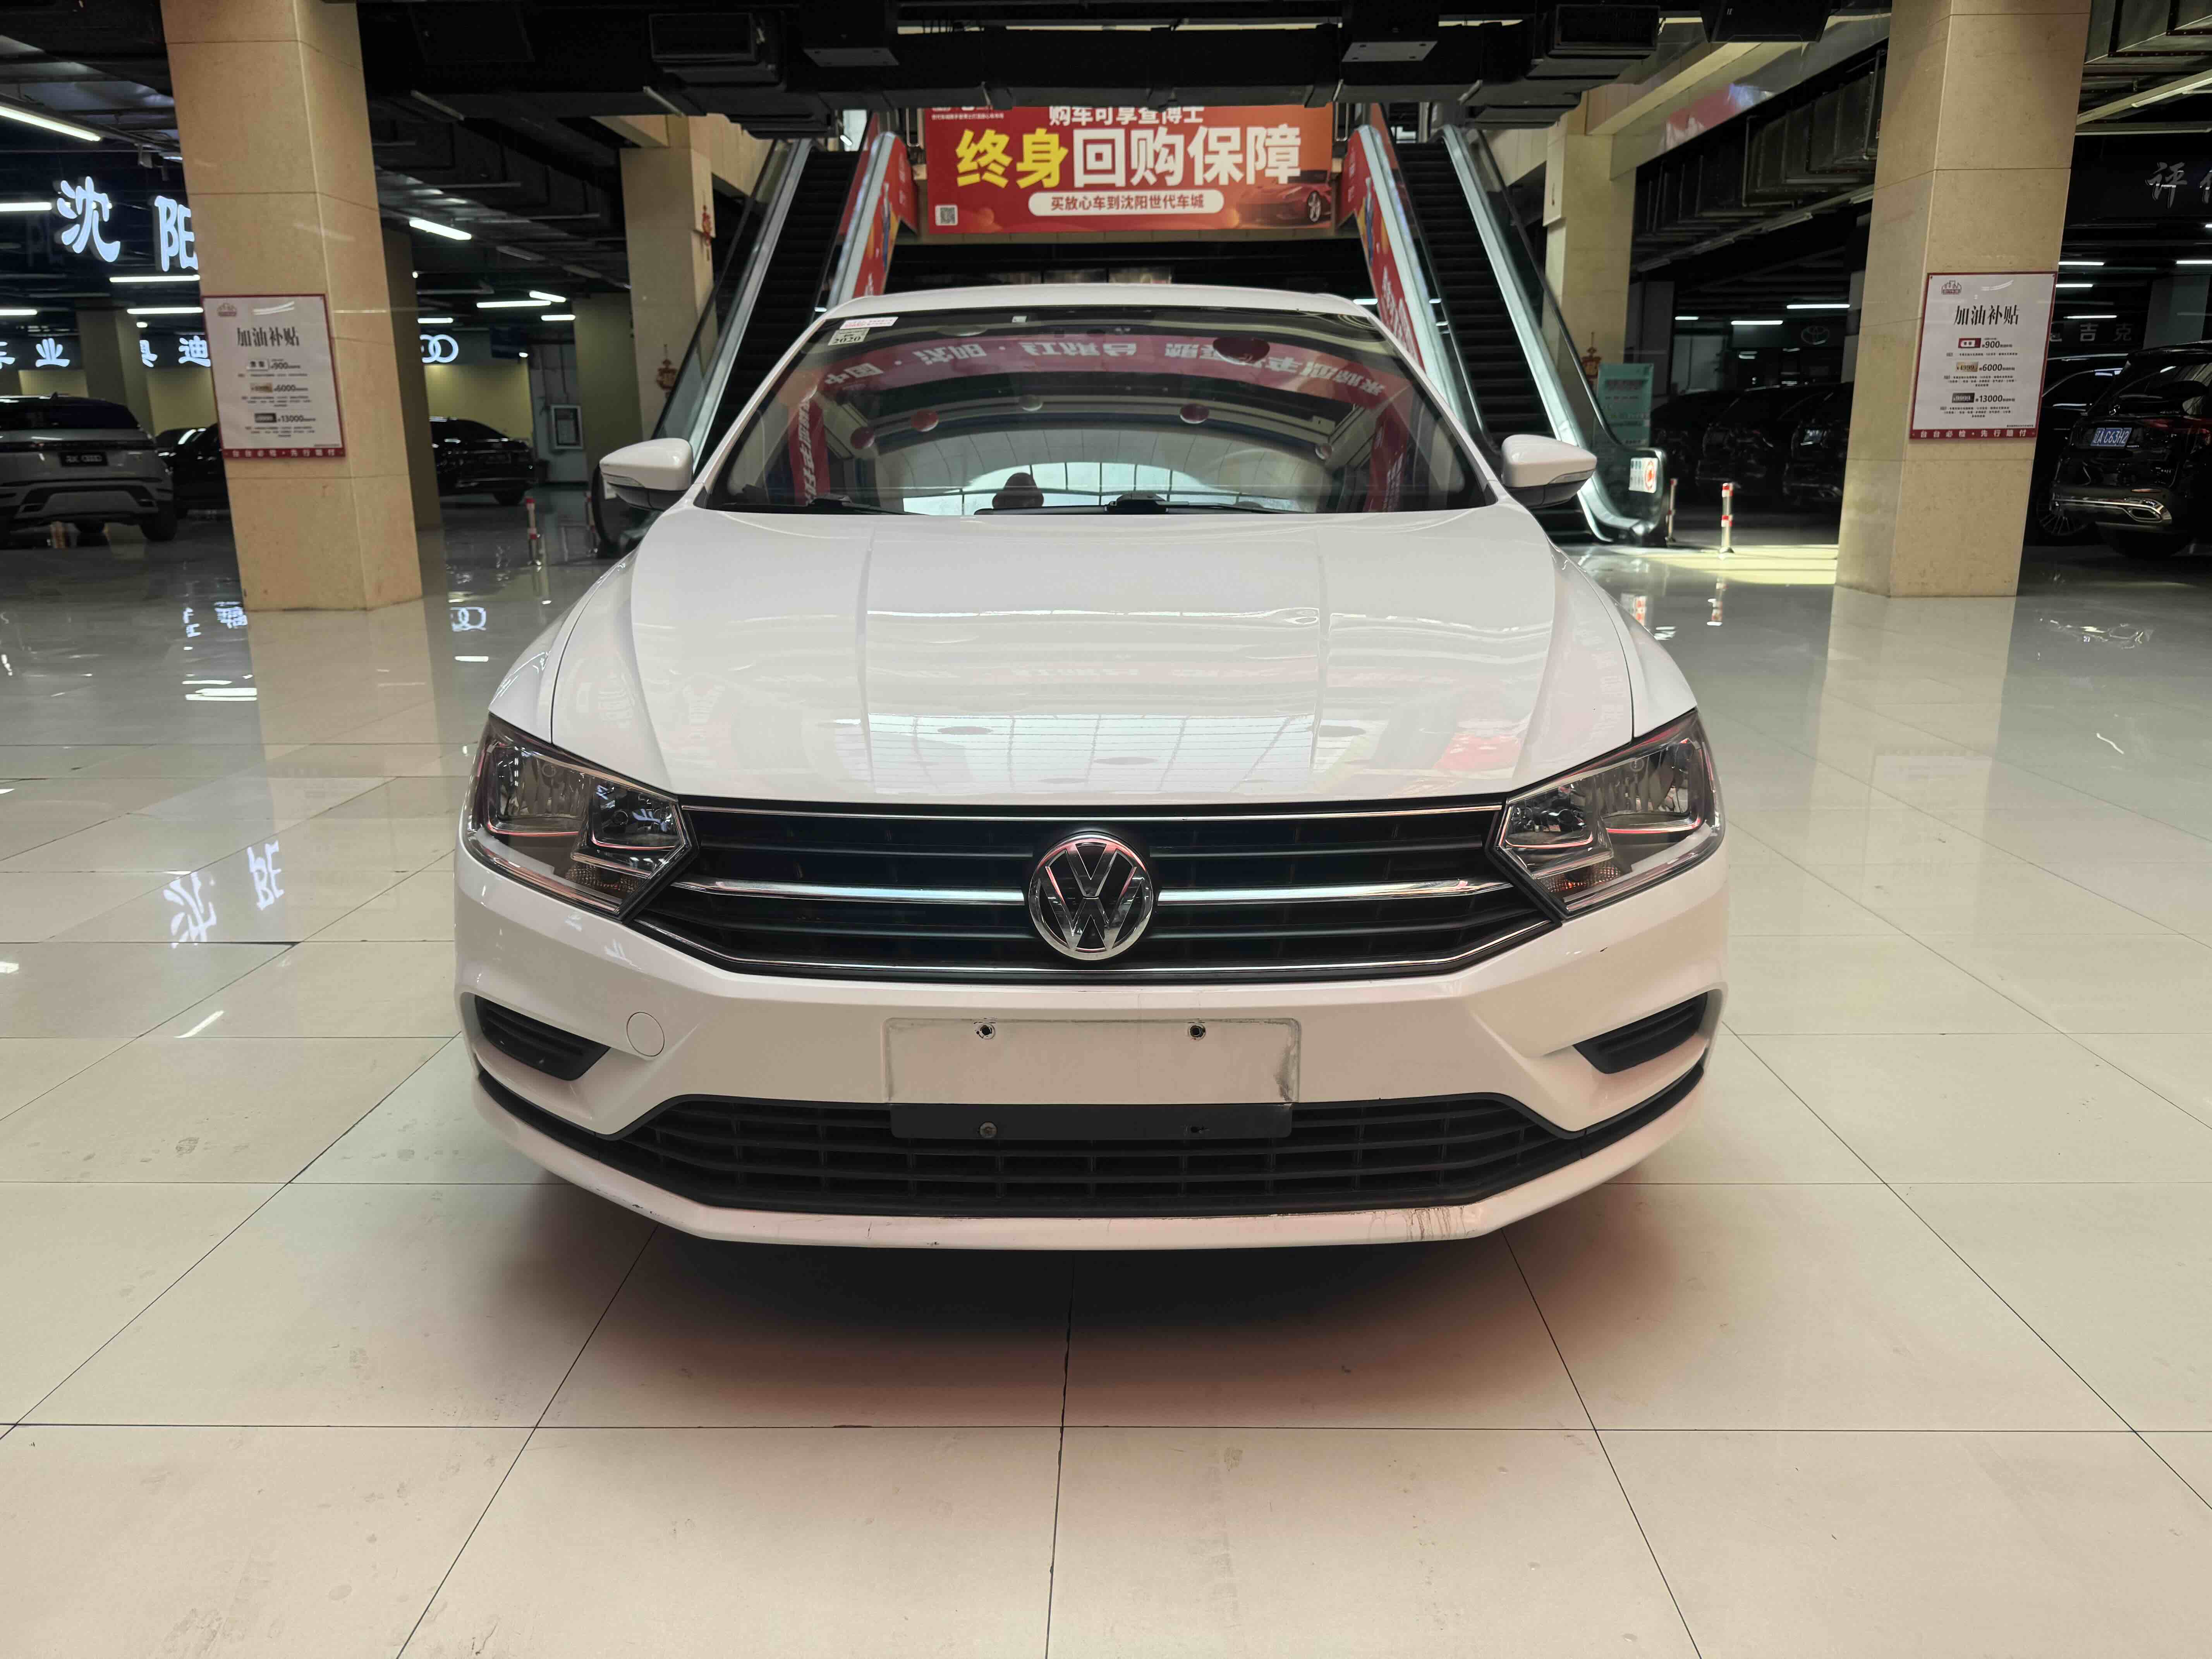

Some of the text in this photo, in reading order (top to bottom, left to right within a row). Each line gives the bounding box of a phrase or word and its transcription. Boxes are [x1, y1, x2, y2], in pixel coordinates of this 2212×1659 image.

[955, 124, 1301, 189] 终身回购保障
[1051, 195, 1204, 211] 买放心车到沈阳世代车城
[1954, 305, 2020, 325] 加油补贴
[237, 327, 299, 347] 加油补贴
